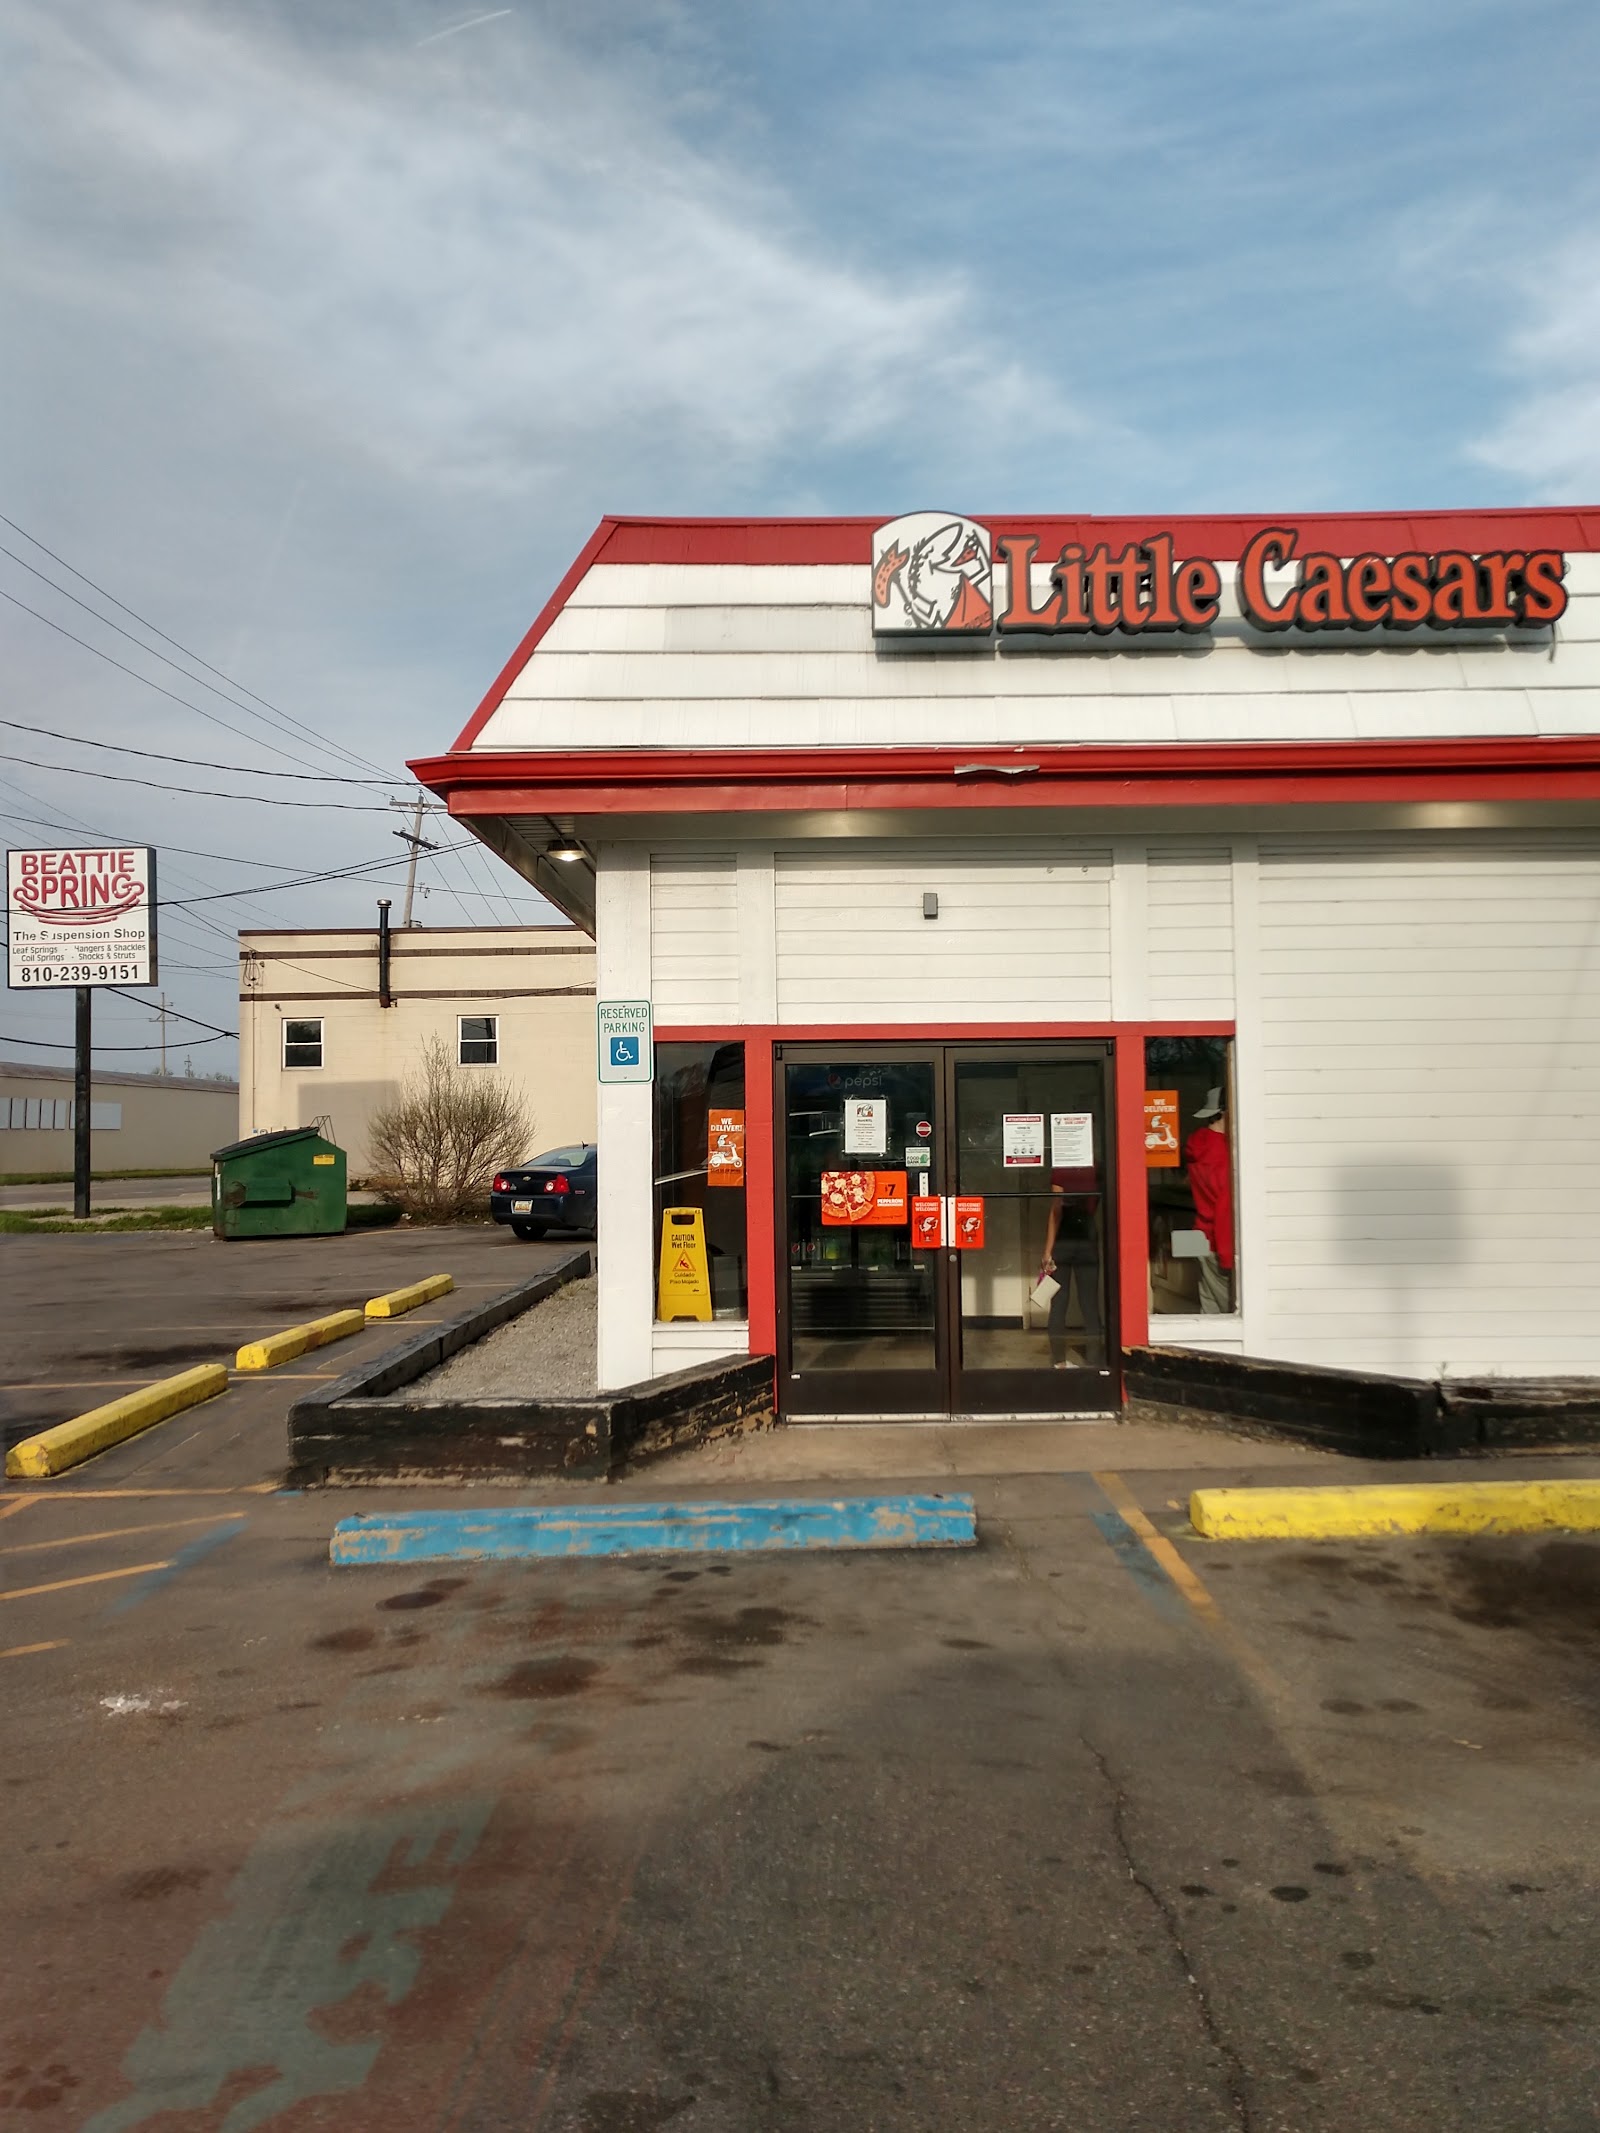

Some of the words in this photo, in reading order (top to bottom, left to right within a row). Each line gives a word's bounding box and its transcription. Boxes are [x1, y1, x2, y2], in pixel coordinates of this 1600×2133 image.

[998, 532, 1221, 633] Little
[1240, 526, 1568, 628] Caesars
[21, 851, 135, 875] BEATTIE
[14, 873, 144, 907] SPRING
[13, 931, 37, 941] The
[113, 928, 146, 940] Shop
[12, 946, 28, 954] Leaf
[30, 946, 58, 955] Springs
[114, 943, 146, 951] Shackles
[21, 954, 35, 962] Coil
[37, 953, 65, 962] Springs
[78, 952, 104, 960] Shocks
[113, 951, 136, 959] Struts
[21, 964, 139, 982] 810-239-9151
[600, 1007, 648, 1019] RESERVED
[603, 1021, 645, 1033] PARKING
[844, 1075, 882, 1089] pepsi
[720, 1117, 733, 1125] WE
[671, 1234, 695, 1242] CAUTION
